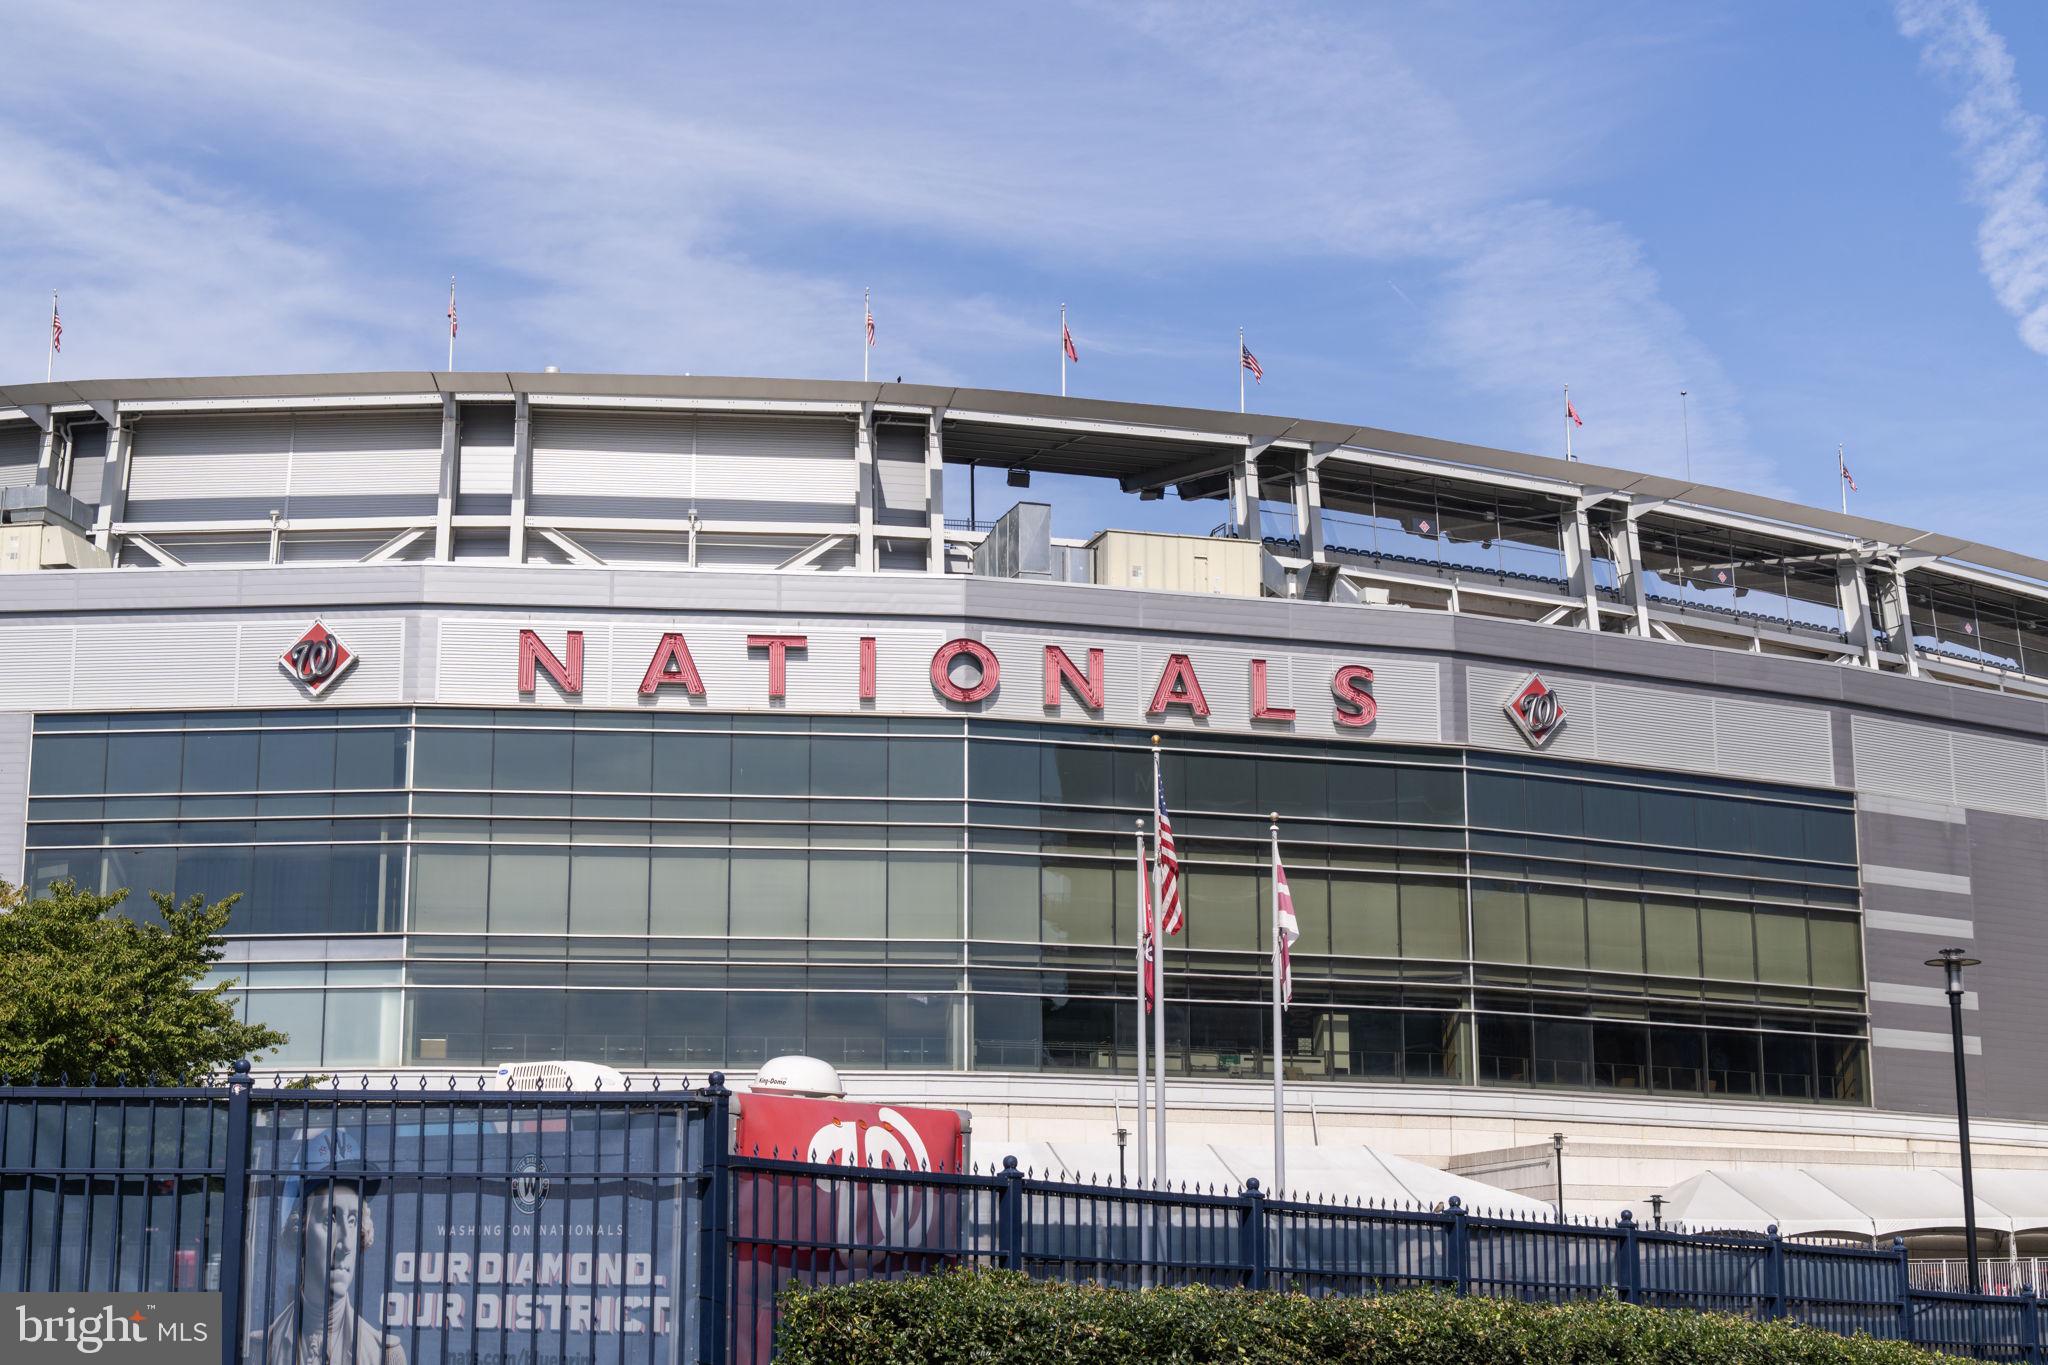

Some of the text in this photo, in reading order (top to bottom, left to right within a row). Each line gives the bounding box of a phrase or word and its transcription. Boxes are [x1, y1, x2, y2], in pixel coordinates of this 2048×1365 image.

[517, 629, 1377, 728] NATIONALS
[437, 1225, 530, 1236] WASHNGON
[395, 1252, 667, 1287] OUR DIAMOND.
[379, 1292, 465, 1331] OUR
